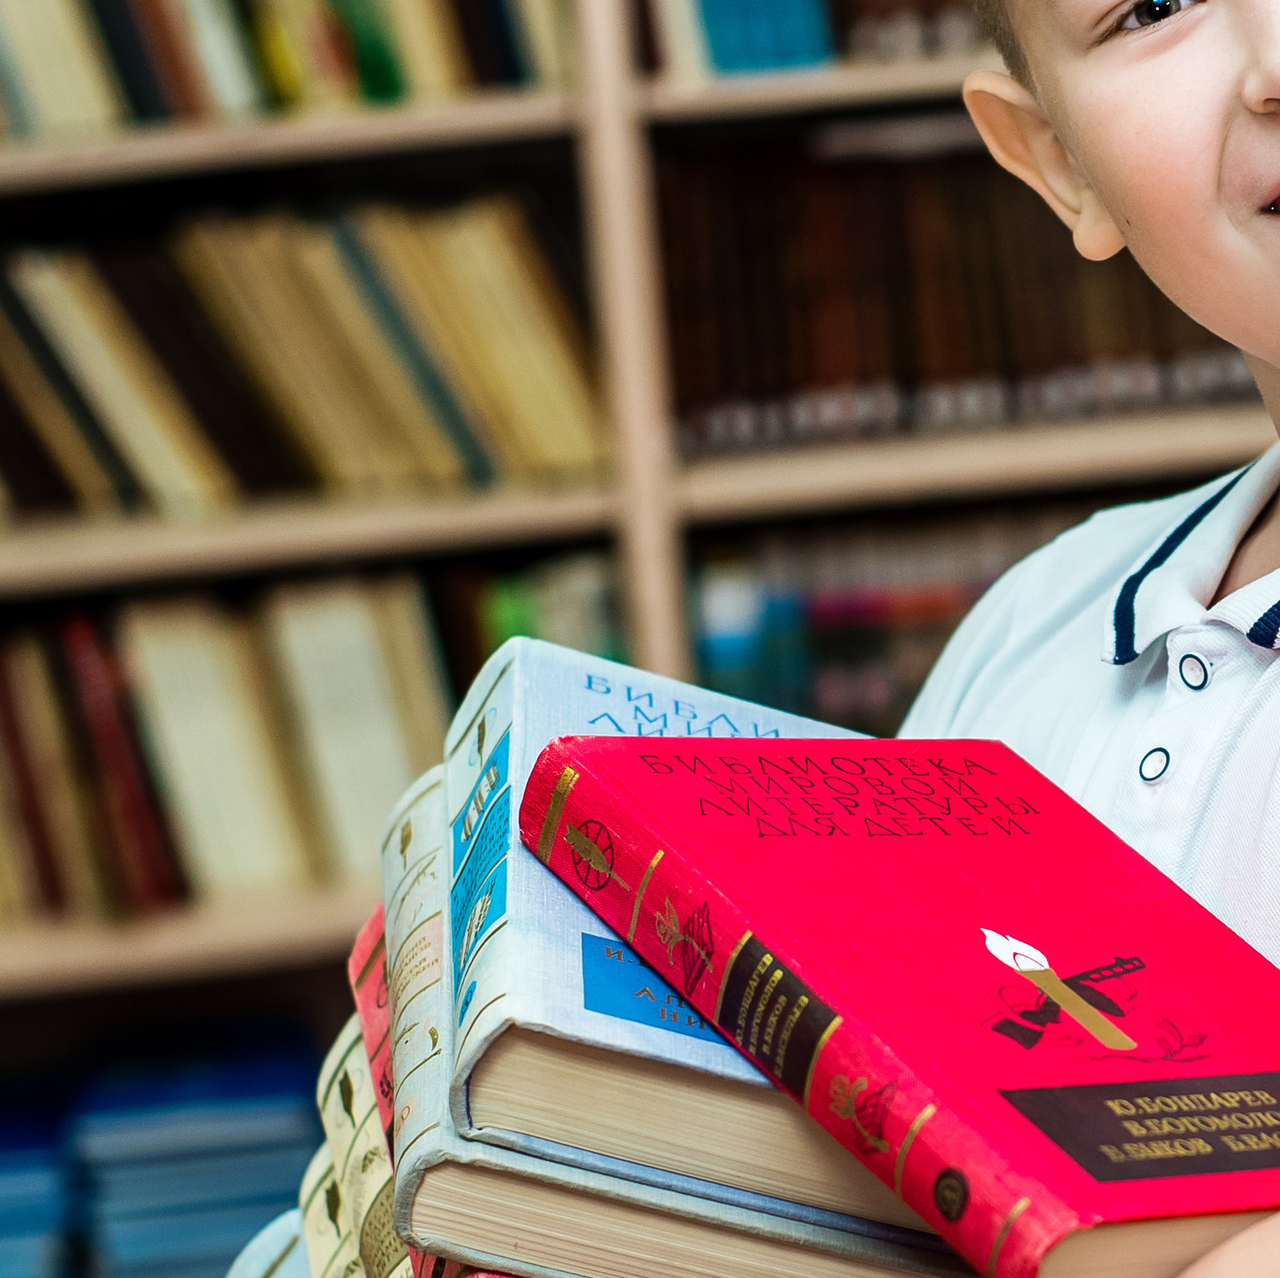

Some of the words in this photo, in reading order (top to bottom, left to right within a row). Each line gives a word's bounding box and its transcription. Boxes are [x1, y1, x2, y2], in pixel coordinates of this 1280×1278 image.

[636, 754, 998, 777] БИБЛИОТЕКА
[704, 775, 981, 797] МИРОВОЙ
[699, 796, 1041, 818] ЛИТЕРАТУРЫ
[756, 817, 850, 838] ДЛЯ
[863, 816, 1031, 838] ДЕТЕЙ
[1105, 1090, 1277, 1116] Ю.БОНДАРЕВ
[1098, 1137, 1214, 1162] В.БЫКОВ
